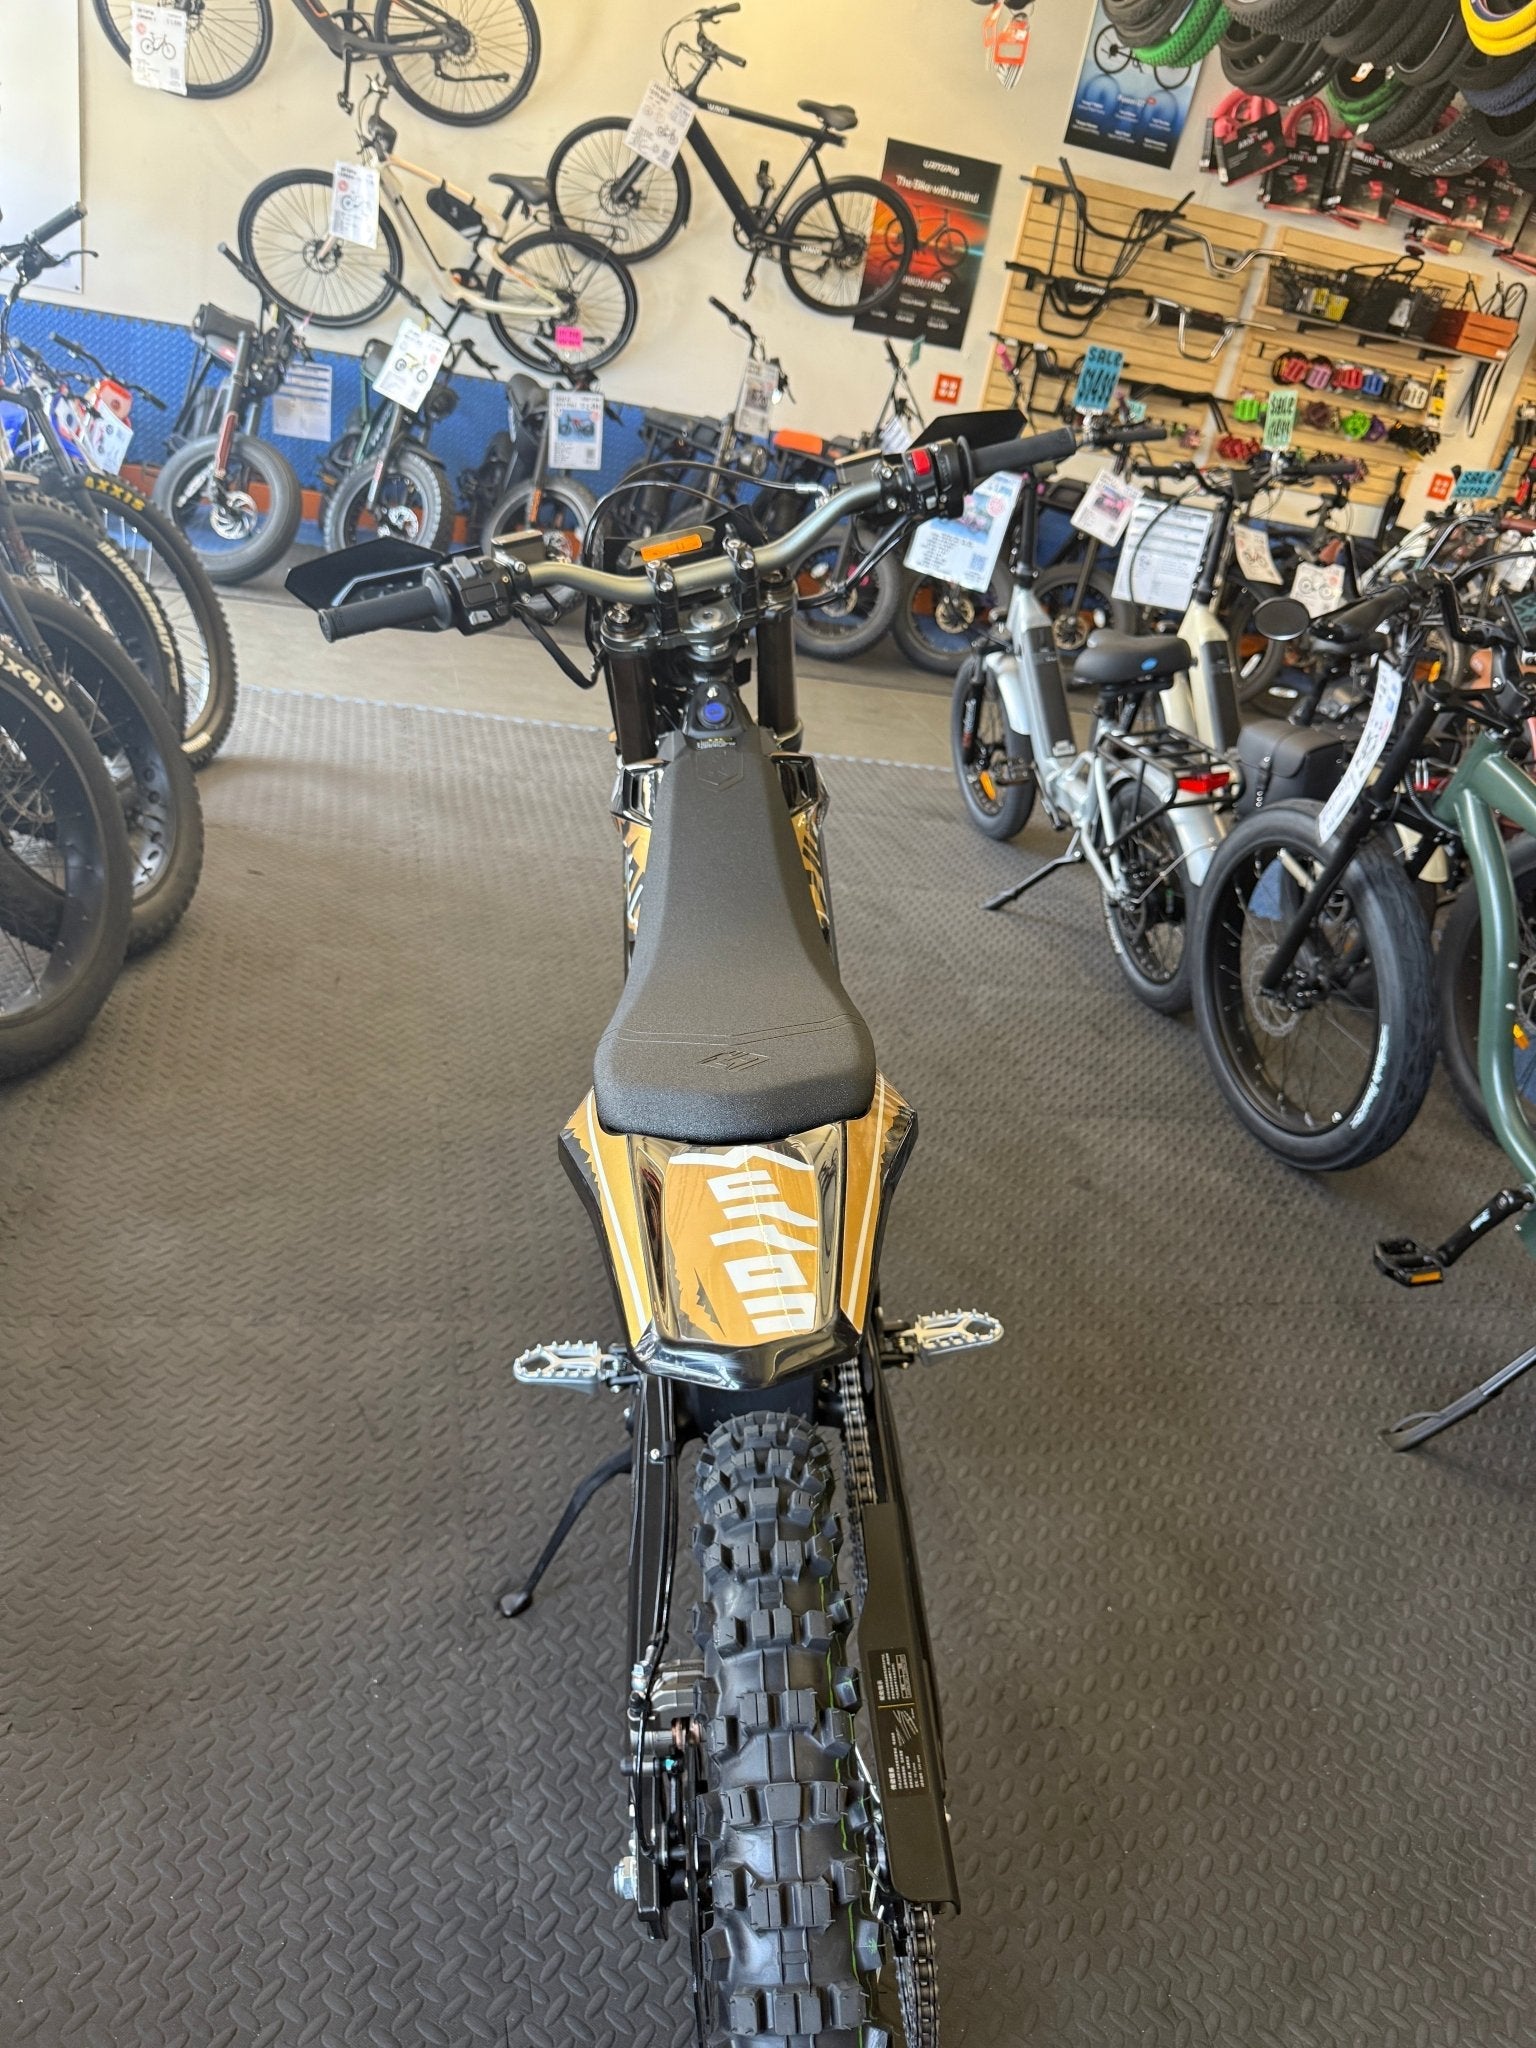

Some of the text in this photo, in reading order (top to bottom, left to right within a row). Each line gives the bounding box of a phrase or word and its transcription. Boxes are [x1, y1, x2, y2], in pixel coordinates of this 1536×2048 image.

[896, 174, 913, 190] The
[913, 177, 932, 194] Bike
[1088, 346, 1124, 366] SALE
[84, 475, 146, 512] AXXIS
